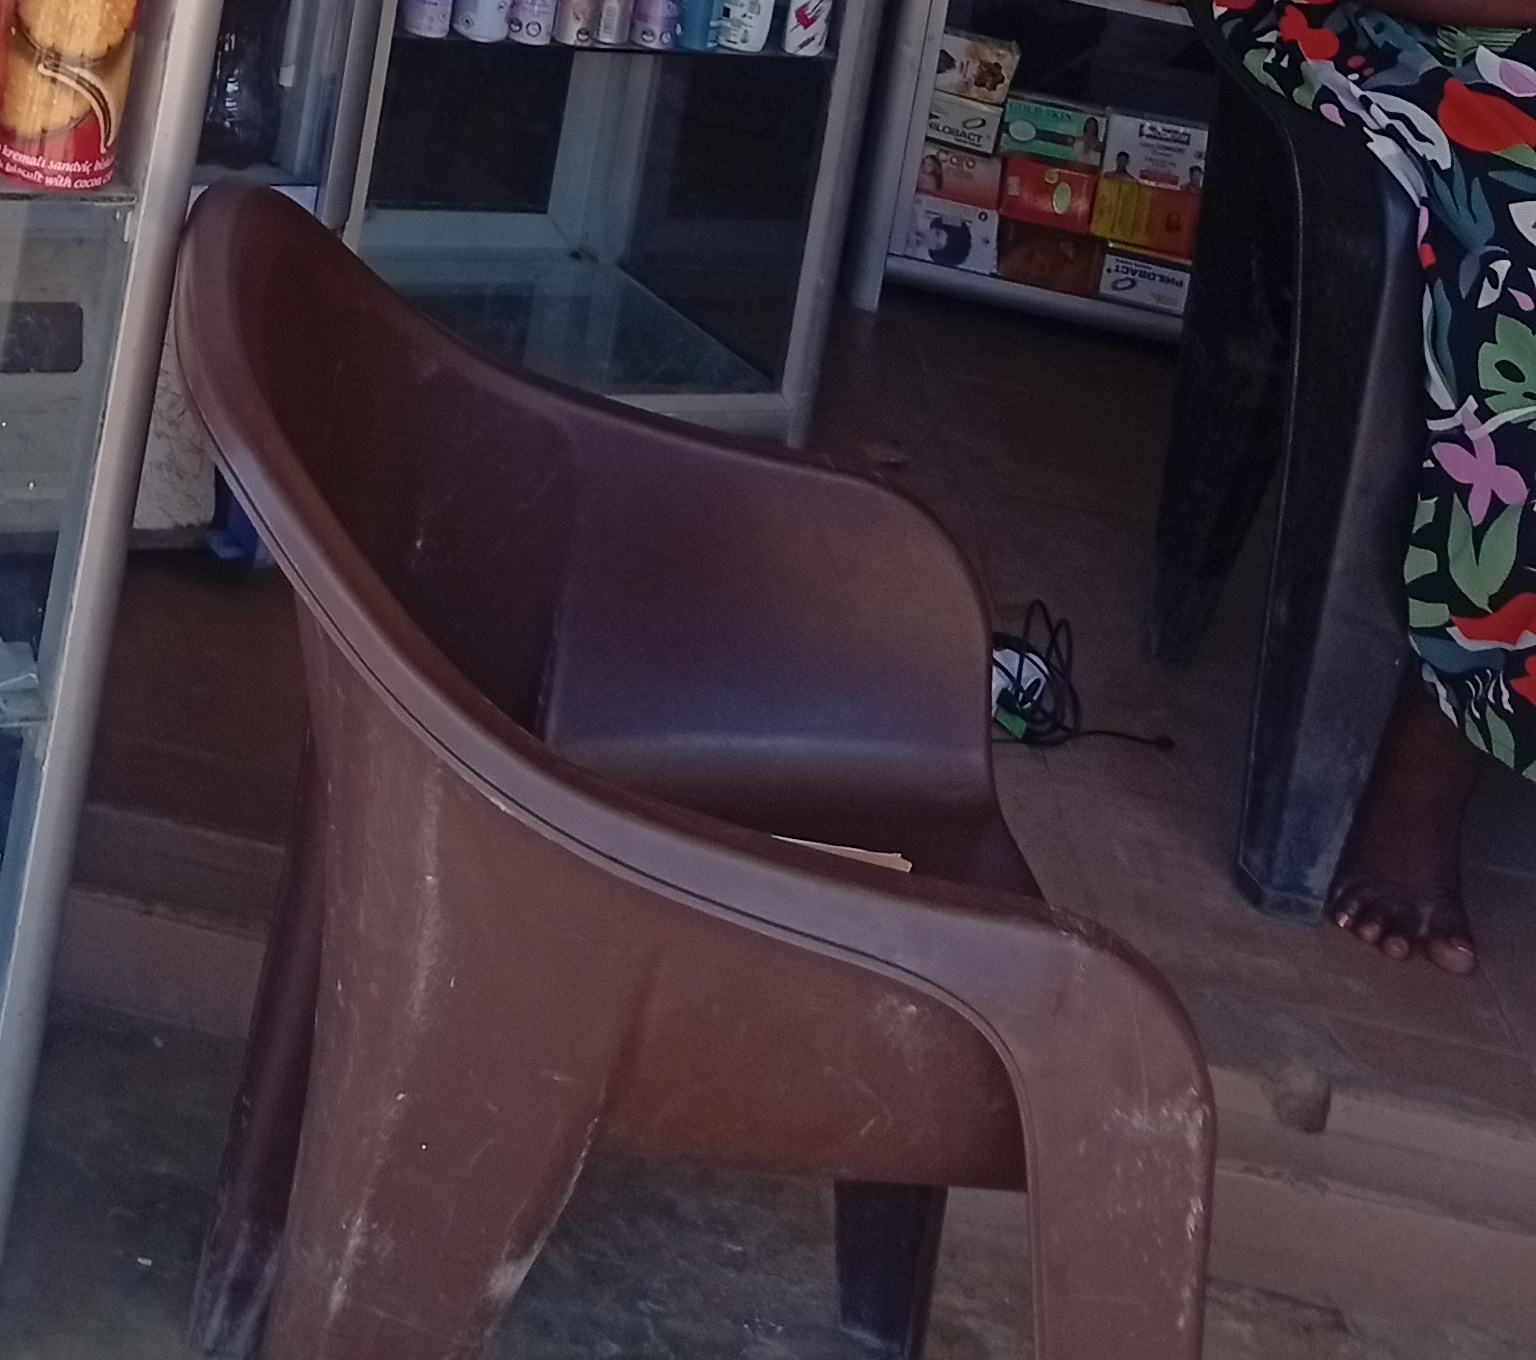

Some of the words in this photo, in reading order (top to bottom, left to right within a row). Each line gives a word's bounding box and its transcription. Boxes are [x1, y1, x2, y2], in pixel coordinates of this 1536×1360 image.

[5, 162, 43, 182] biscuit
[45, 174, 72, 189] with
[74, 178, 103, 189] cocoa
